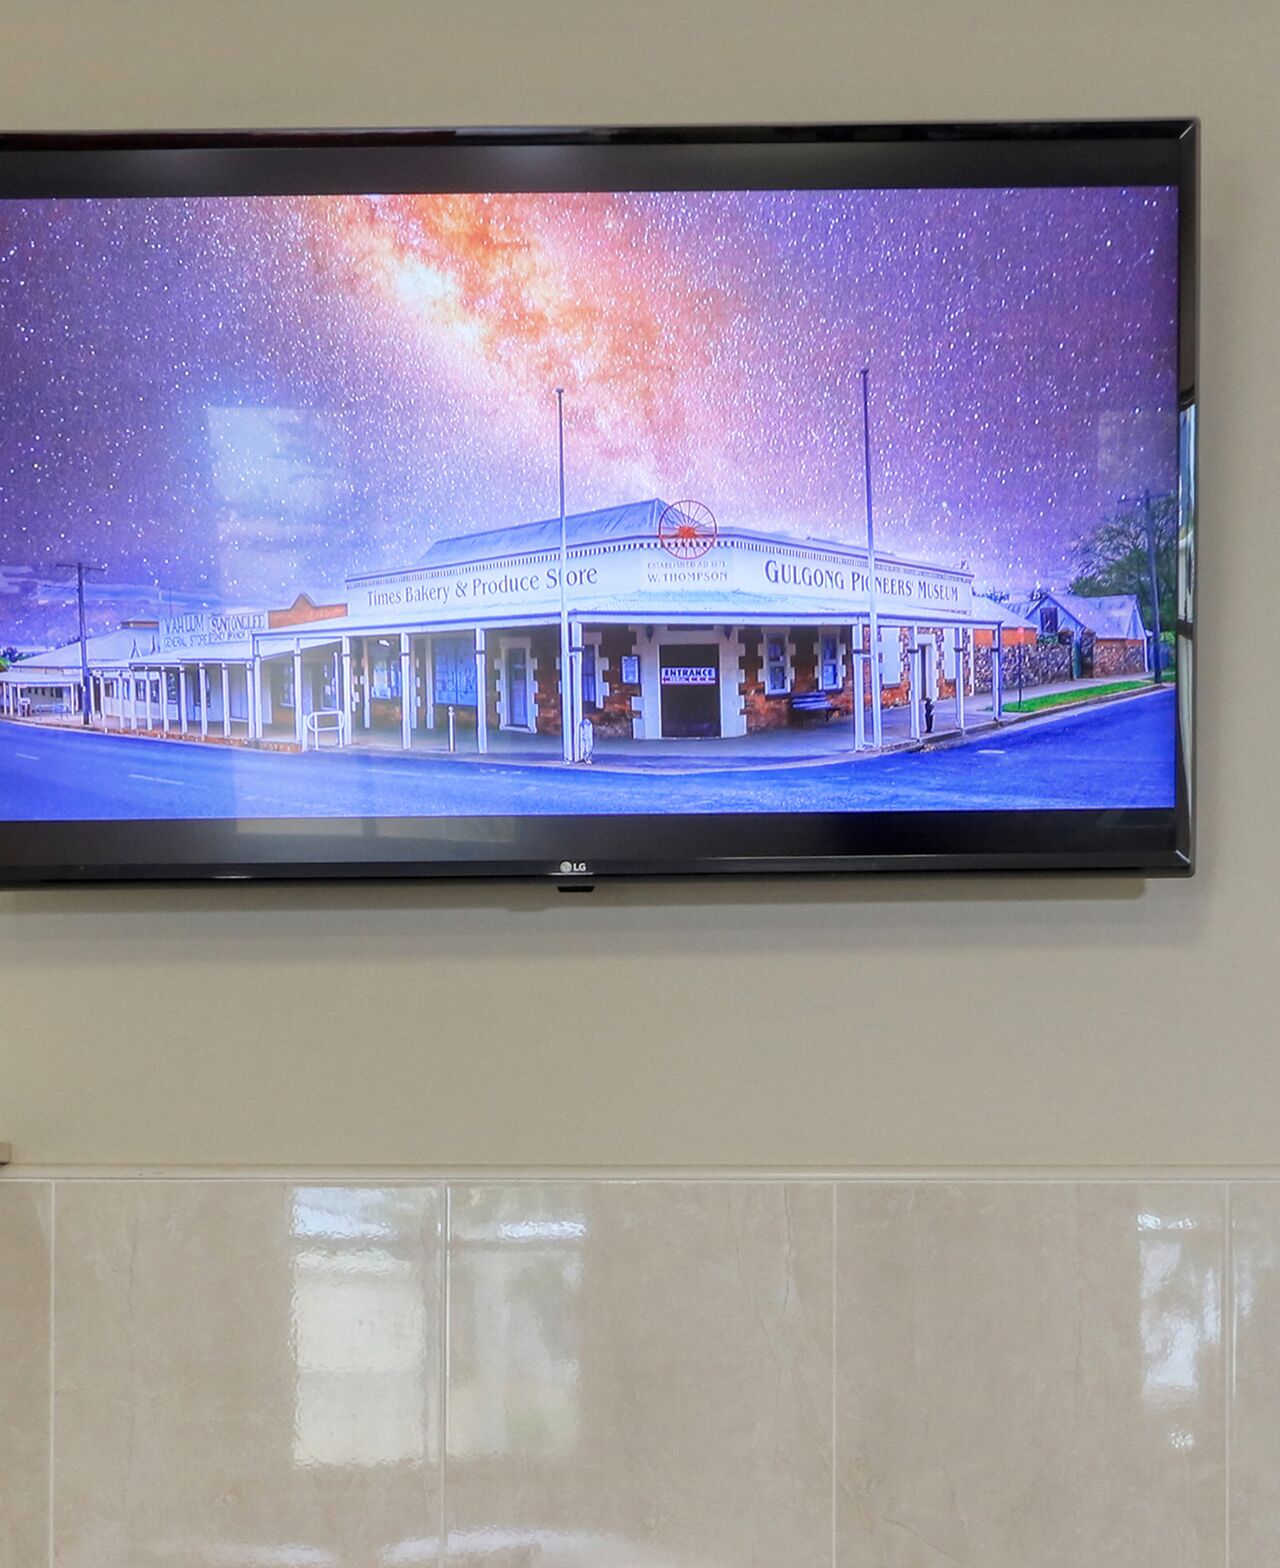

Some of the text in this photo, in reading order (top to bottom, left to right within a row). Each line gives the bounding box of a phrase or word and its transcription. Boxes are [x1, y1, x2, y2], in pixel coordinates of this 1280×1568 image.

[663, 571, 728, 582] THOMPSON
[765, 560, 846, 590] GULGONG
[917, 580, 960, 602] MUSEUM
[367, 566, 599, 608] Times Bakery & Produce Store
[664, 668, 713, 677] ENTRANCE
[572, 862, 587, 872] LG
